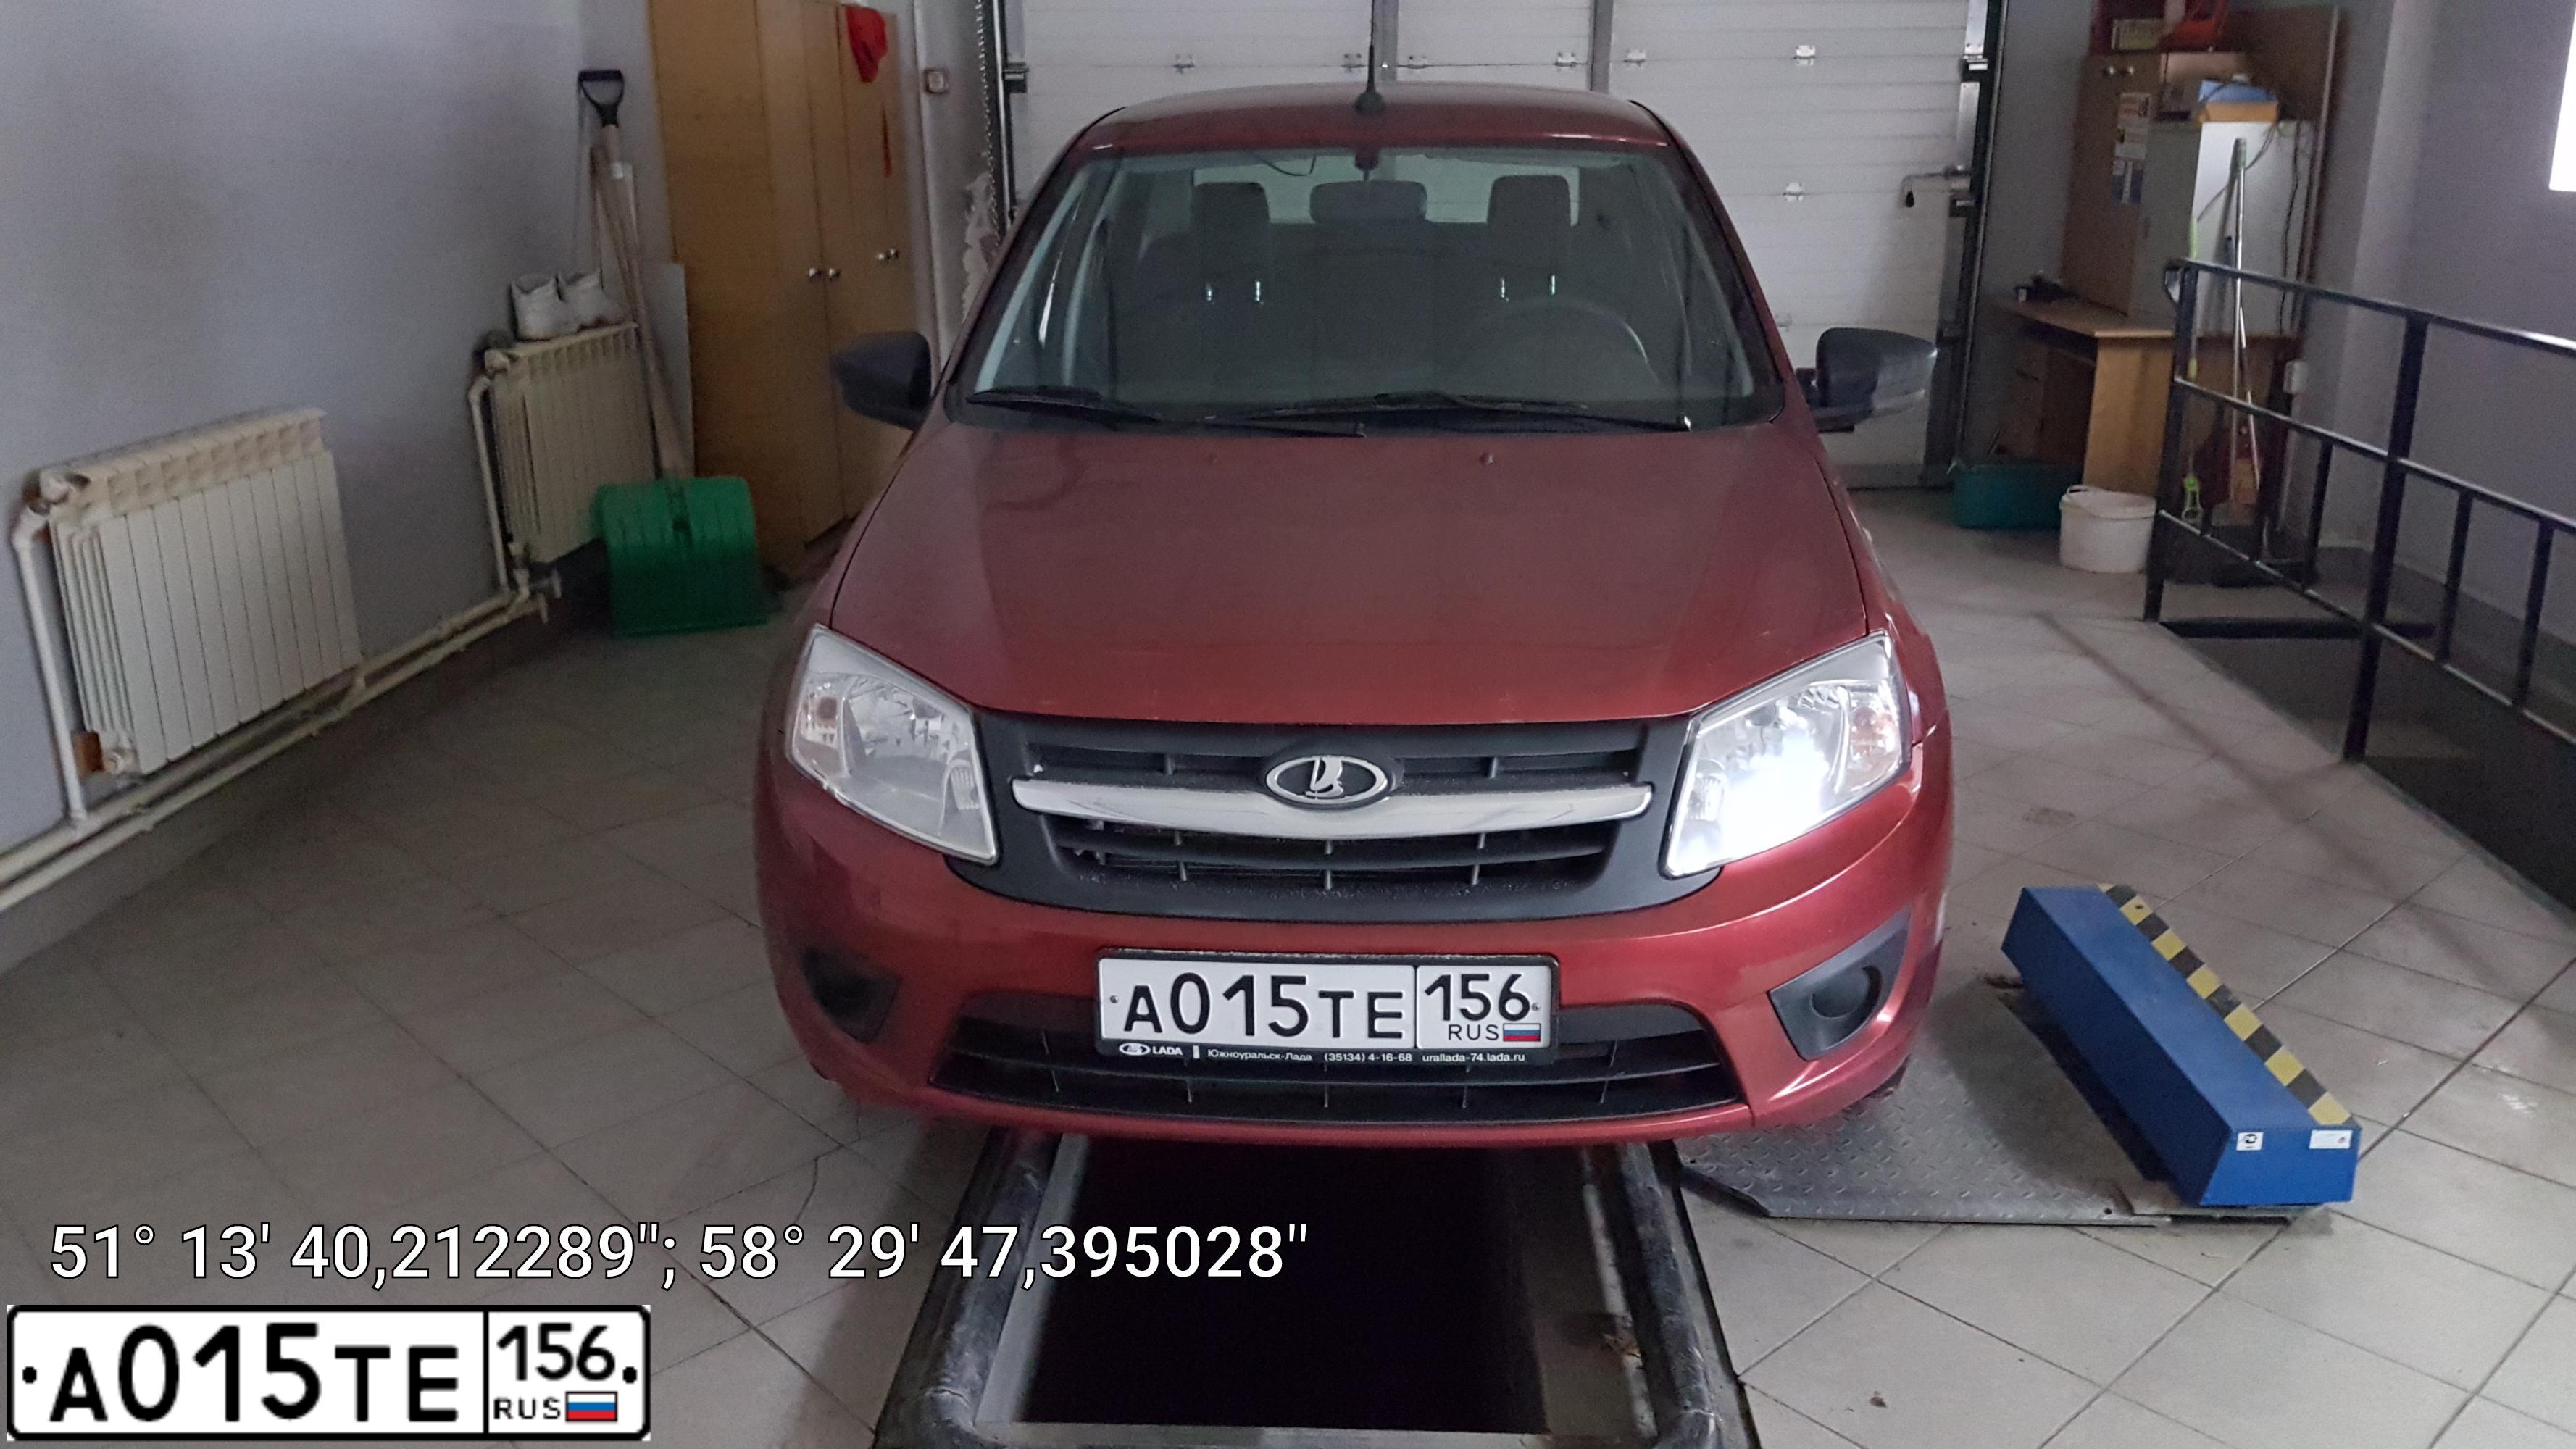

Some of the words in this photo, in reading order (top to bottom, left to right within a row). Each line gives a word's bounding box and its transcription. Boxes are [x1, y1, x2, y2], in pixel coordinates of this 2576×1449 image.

[1424, 973, 1531, 1022] 156
[1449, 1023, 1499, 1041] RUS
[1152, 1045, 1183, 1056] LADA
[1207, 1048, 1313, 1061] Южноуральск-Лада
[1324, 1052, 1366, 1063] (35134)
[1367, 1053, 1412, 1063] 4-16-68
[1422, 1052, 1525, 1063] urallada-74.lada.ru
